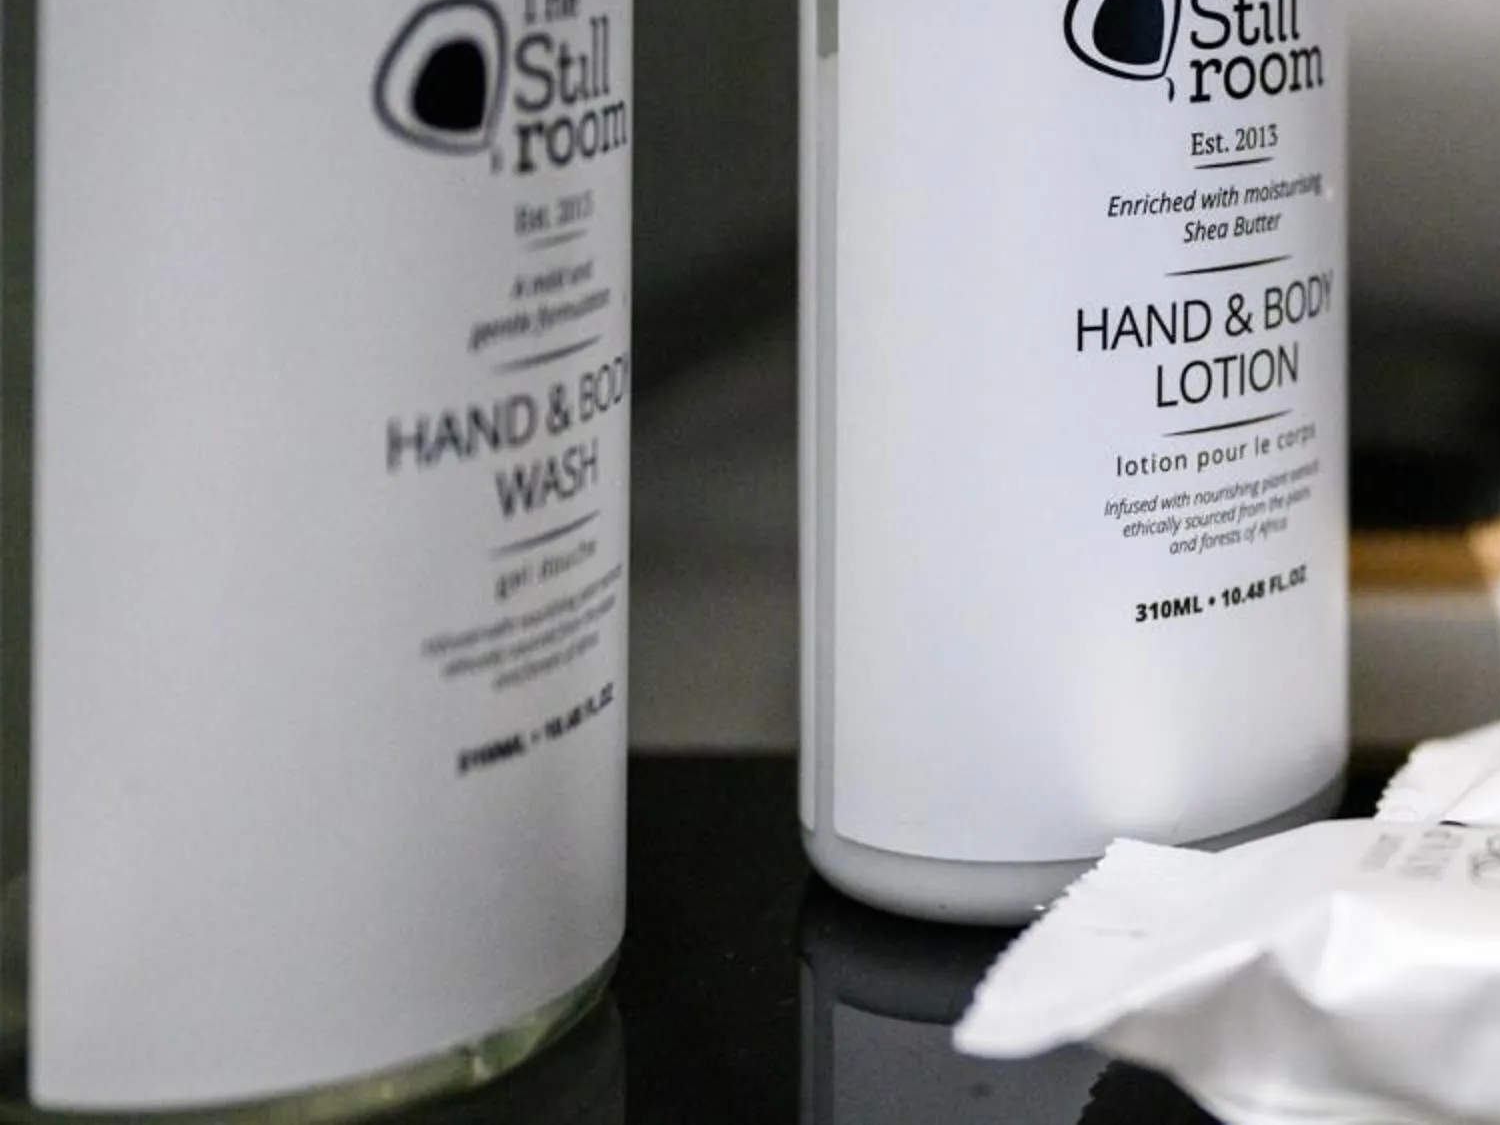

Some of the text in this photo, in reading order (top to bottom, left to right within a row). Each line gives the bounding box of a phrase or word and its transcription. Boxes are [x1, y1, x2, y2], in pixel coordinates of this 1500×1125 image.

[513, 13, 610, 113] Still
[1189, 45, 1324, 103] room
[513, 100, 627, 174] room
[1190, 123, 1279, 156] Est. 2013
[1107, 190, 1197, 217] Enriched
[1201, 185, 1239, 210] with
[1184, 212, 1282, 243] Shea Butter
[1077, 268, 1334, 352] HAND & BODY
[1157, 340, 1299, 407] LOTION
[386, 392, 539, 473] HAND
[545, 381, 571, 436] &
[1116, 453, 1188, 477] lotion
[1197, 443, 1247, 473] pour
[1255, 435, 1270, 456] le
[496, 437, 598, 520] WASH
[1104, 495, 1158, 520] Infused
[1161, 490, 1191, 511] with
[1122, 515, 1181, 538] ethically
[1185, 506, 1236, 531] sourced
[1169, 537, 1197, 555] and
[1135, 596, 1203, 622] 310ML
[1221, 581, 1265, 608] 10.48
